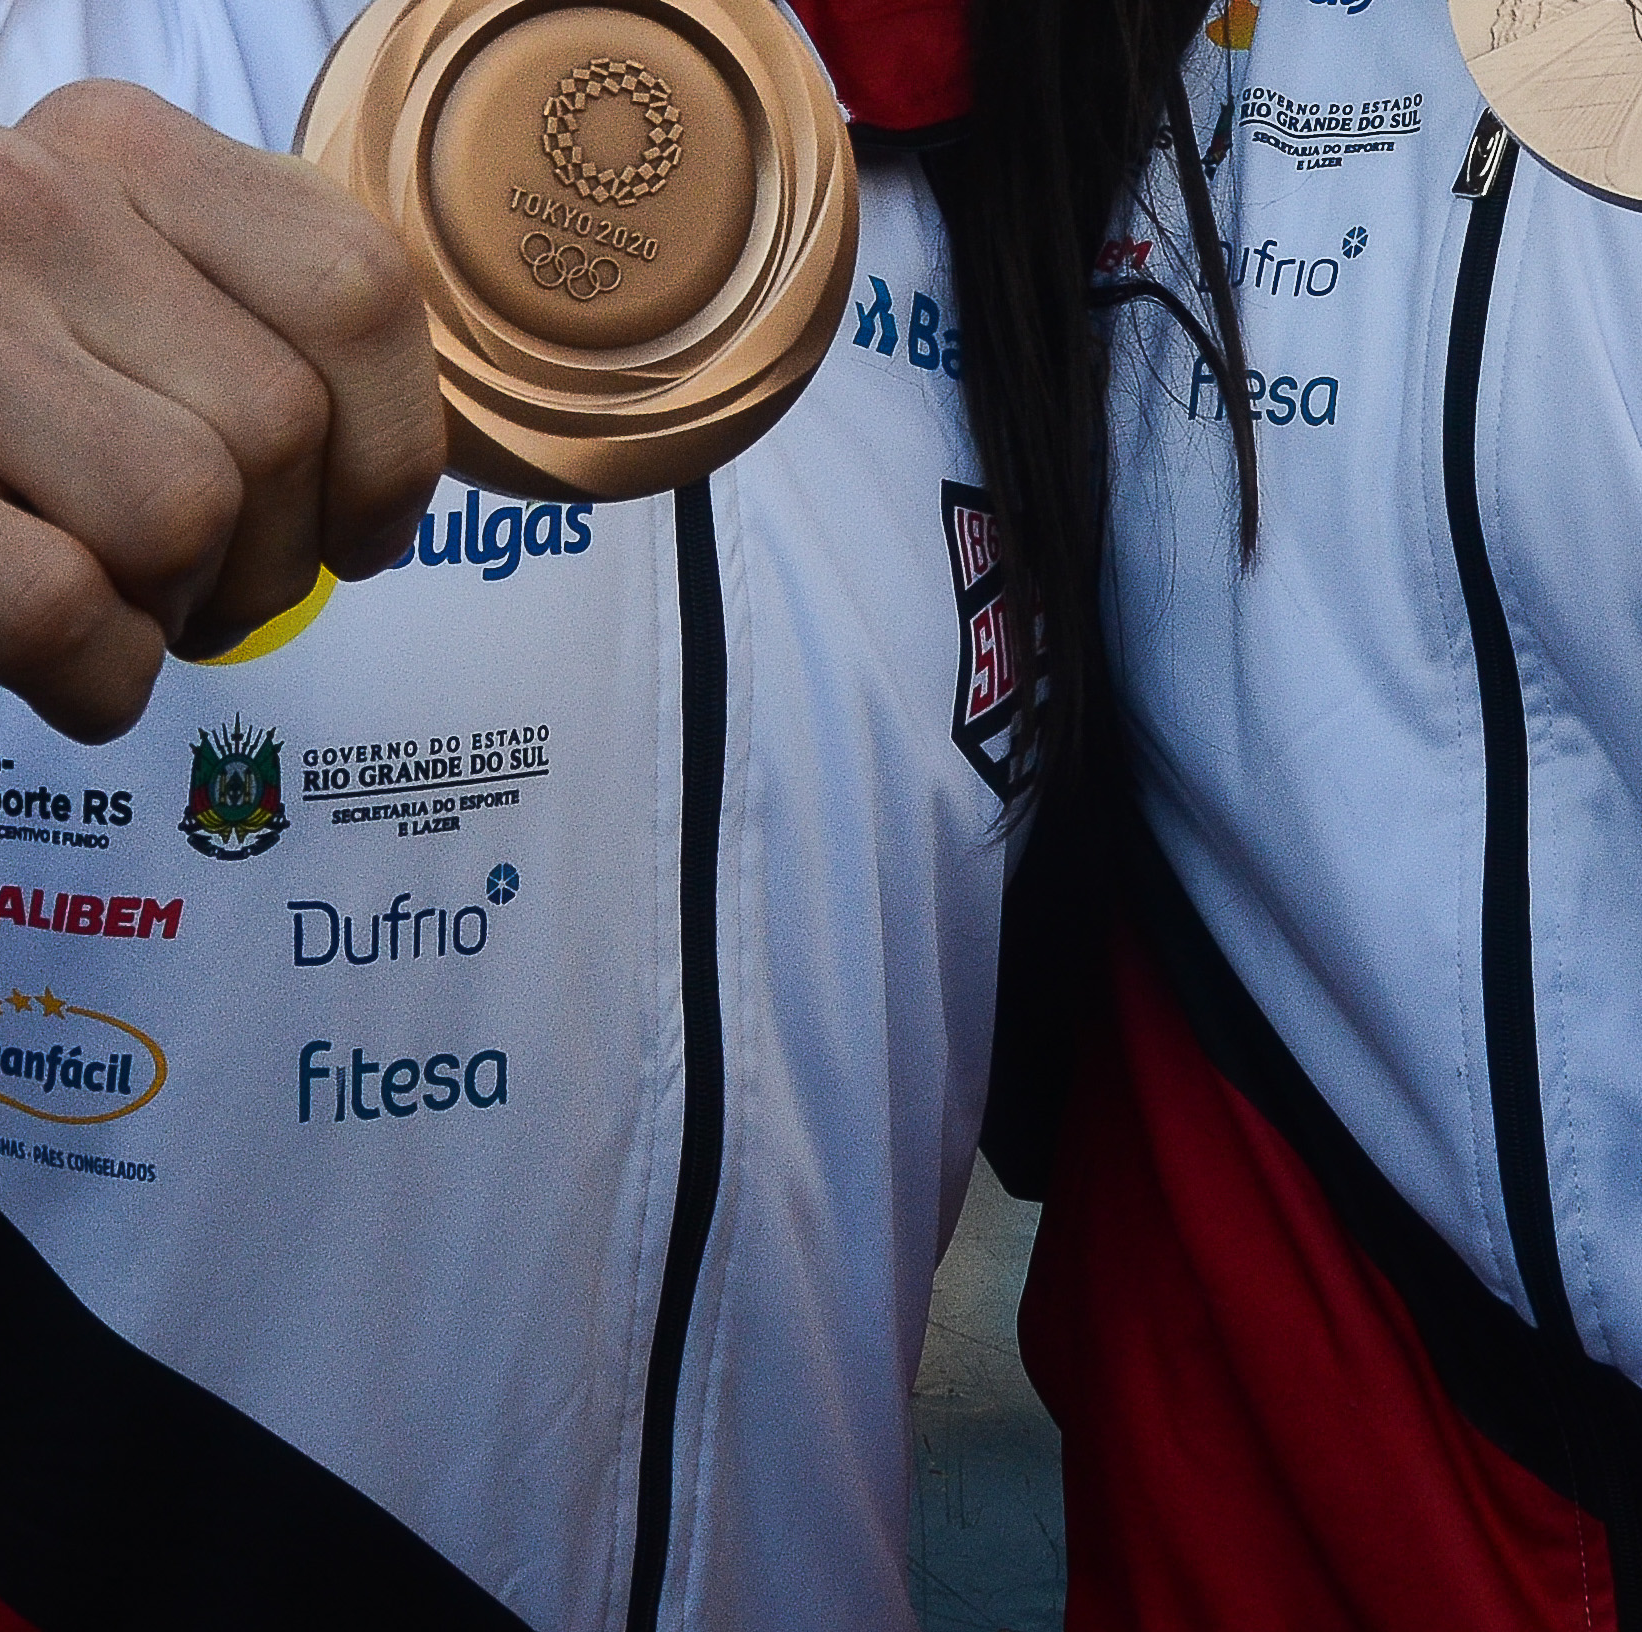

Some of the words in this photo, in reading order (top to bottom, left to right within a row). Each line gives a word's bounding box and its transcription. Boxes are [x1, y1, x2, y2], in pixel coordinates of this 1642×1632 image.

[1240, 101, 1272, 119] RIO
[1275, 110, 1352, 133] GRANDE
[1357, 114, 1385, 132] DO
[1389, 109, 1422, 128] SUL
[1242, 87, 1320, 116] GOVERNO
[1328, 103, 1354, 116] DO
[1361, 93, 1423, 115] ESTADO
[1251, 130, 1320, 157] SECRETARIA
[1322, 144, 1341, 155] DO
[1296, 159, 1305, 171] E
[1306, 156, 1343, 171] LAZER
[509, 185, 592, 236] TOKYO
[595, 220, 658, 260] 2020
[302, 740, 419, 767] GOVERNO
[429, 735, 461, 755] DO
[471, 724, 550, 750] ESTADO
[302, 768, 351, 792] RIO
[358, 756, 463, 788] GRANDE
[470, 751, 504, 775] DO
[510, 745, 550, 770] SUL
[82, 789, 134, 827] RS
[331, 800, 429, 825] SECRETARIA
[432, 797, 456, 814] DO
[459, 789, 520, 811] ESPORTE
[51, 829, 61, 845] E
[61, 830, 110, 850] FUNDO
[398, 821, 409, 837] E
[412, 816, 461, 836] LAZER
[286, 892, 488, 967] Dufrio
[298, 1039, 508, 1123] fitesa
[32, 1144, 64, 1169] PÃES
[66, 1152, 157, 1184] CONGELADOS
